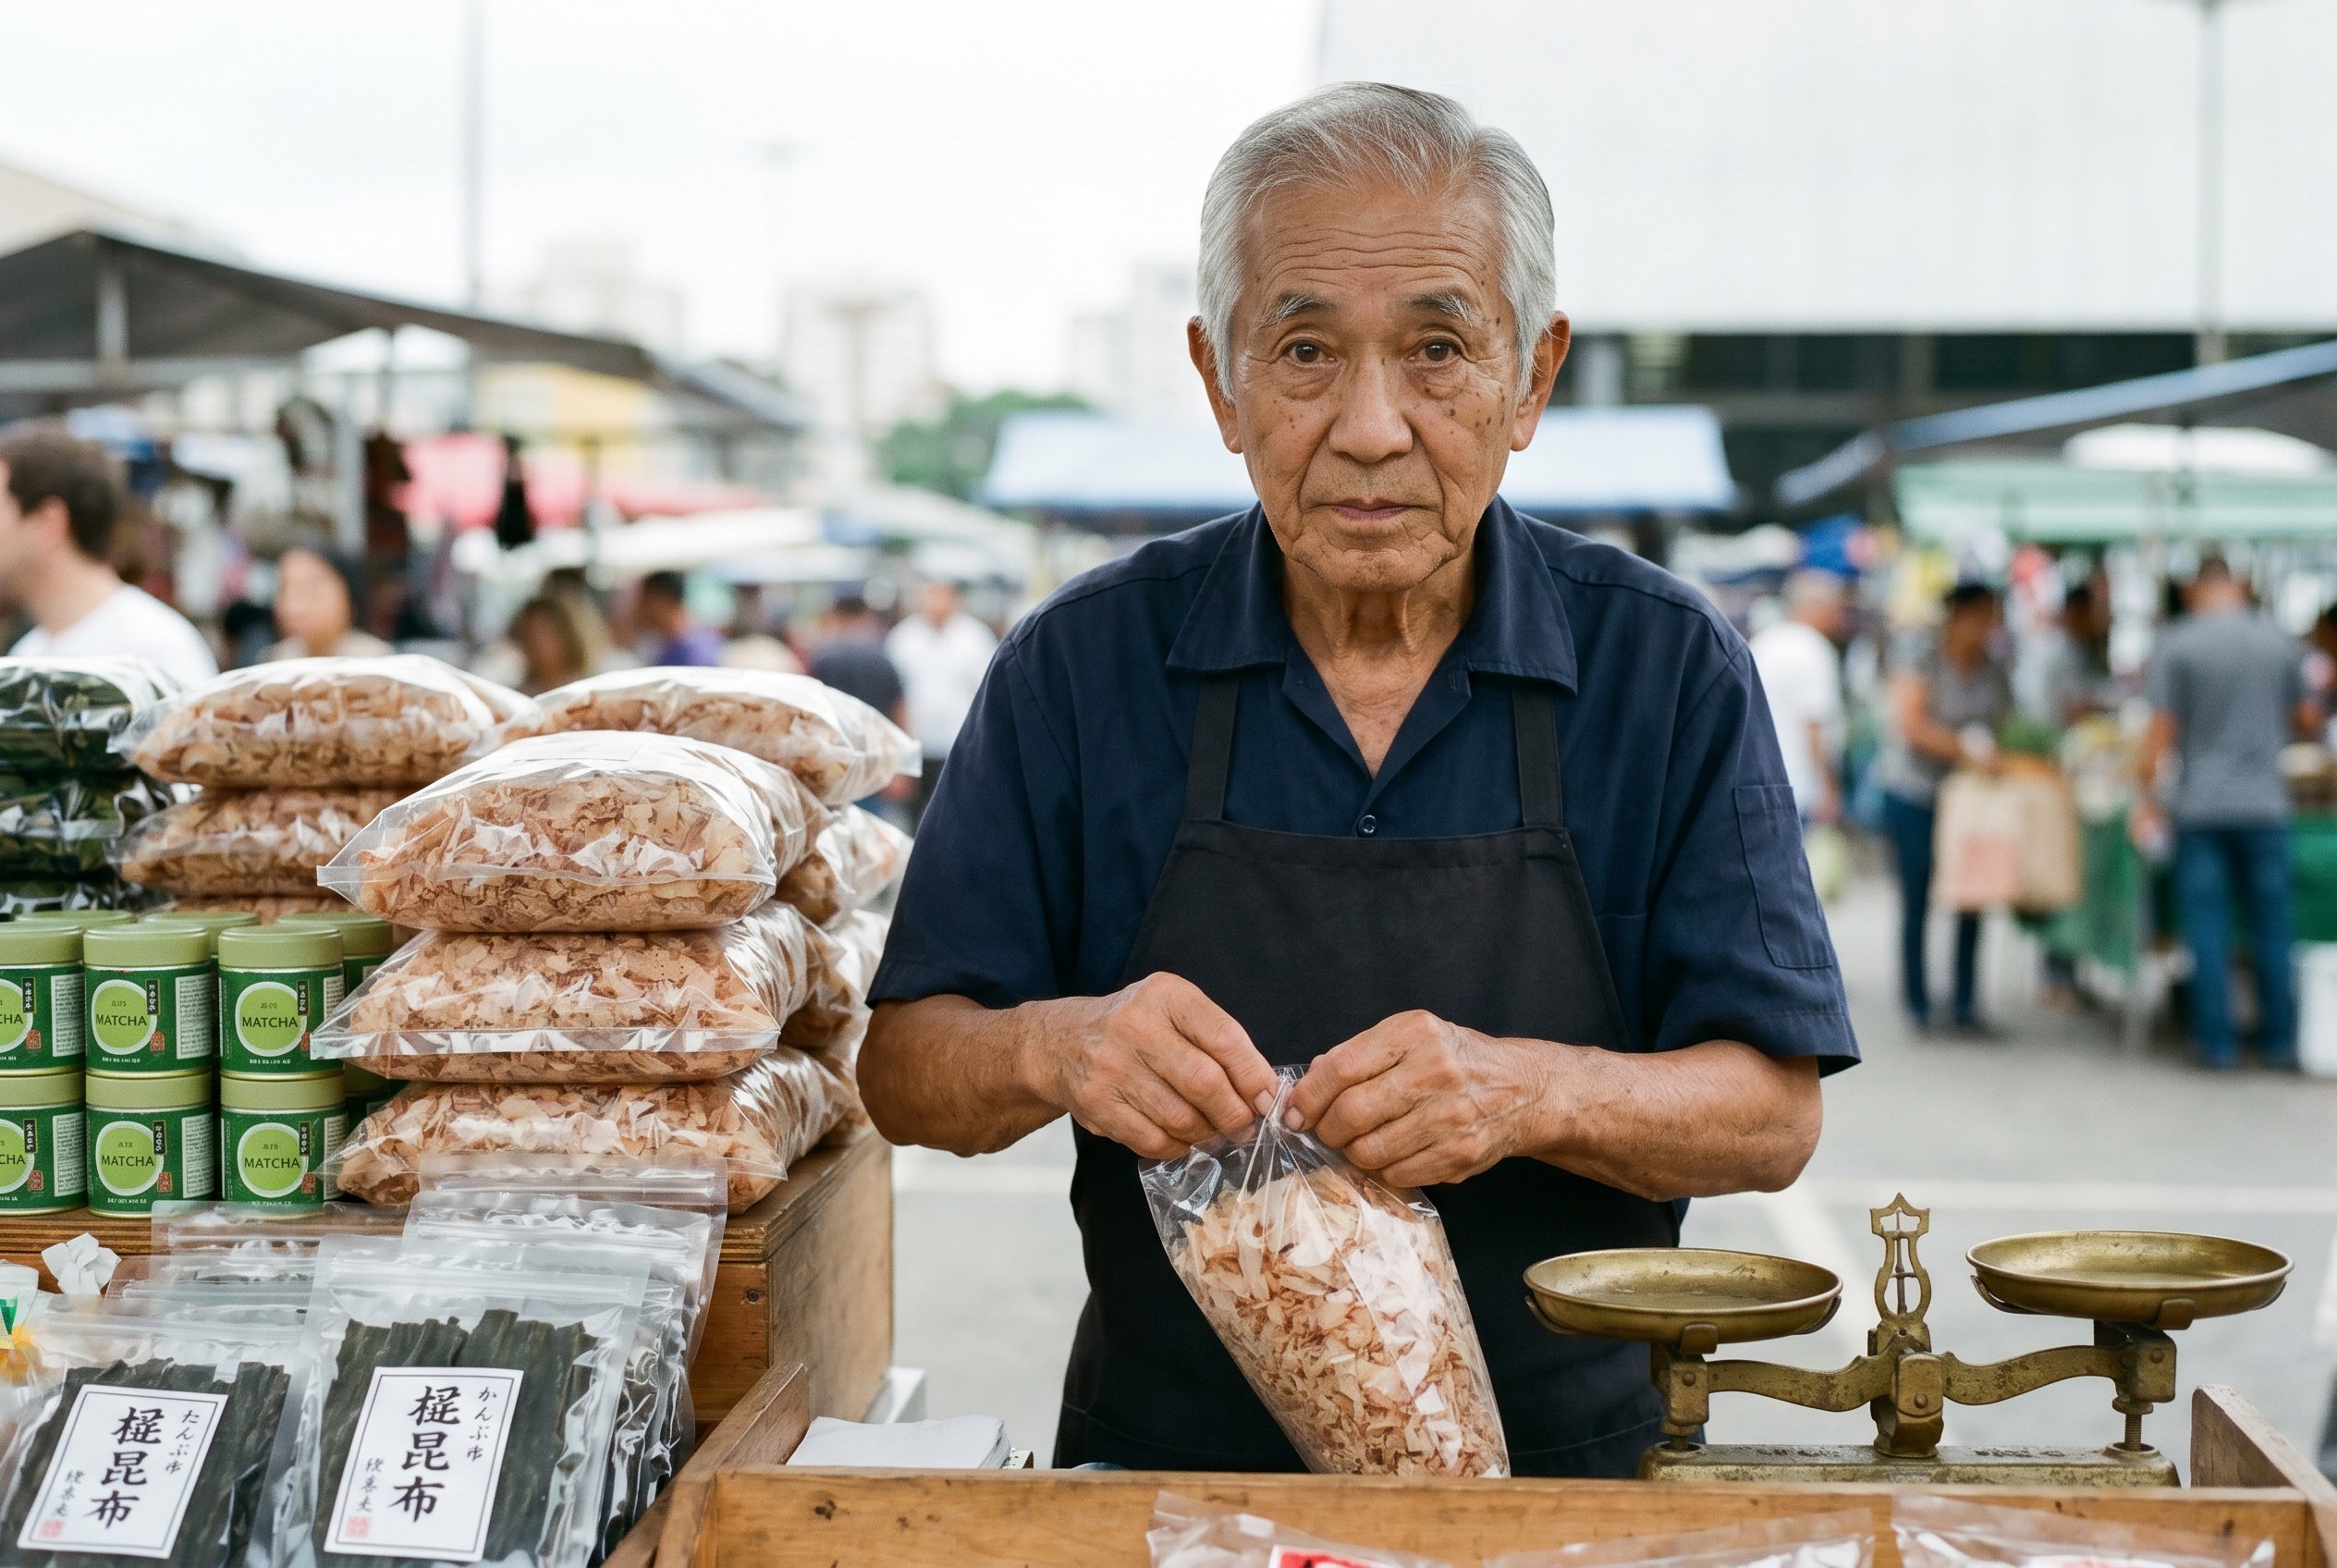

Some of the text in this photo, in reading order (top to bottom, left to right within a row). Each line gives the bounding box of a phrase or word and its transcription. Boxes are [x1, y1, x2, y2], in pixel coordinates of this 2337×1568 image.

[96, 1014, 148, 1026] MATCHA
[242, 1017, 299, 1028] MATCHA
[101, 1155, 155, 1167] MATCHA
[244, 1158, 300, 1169] MATCHA
